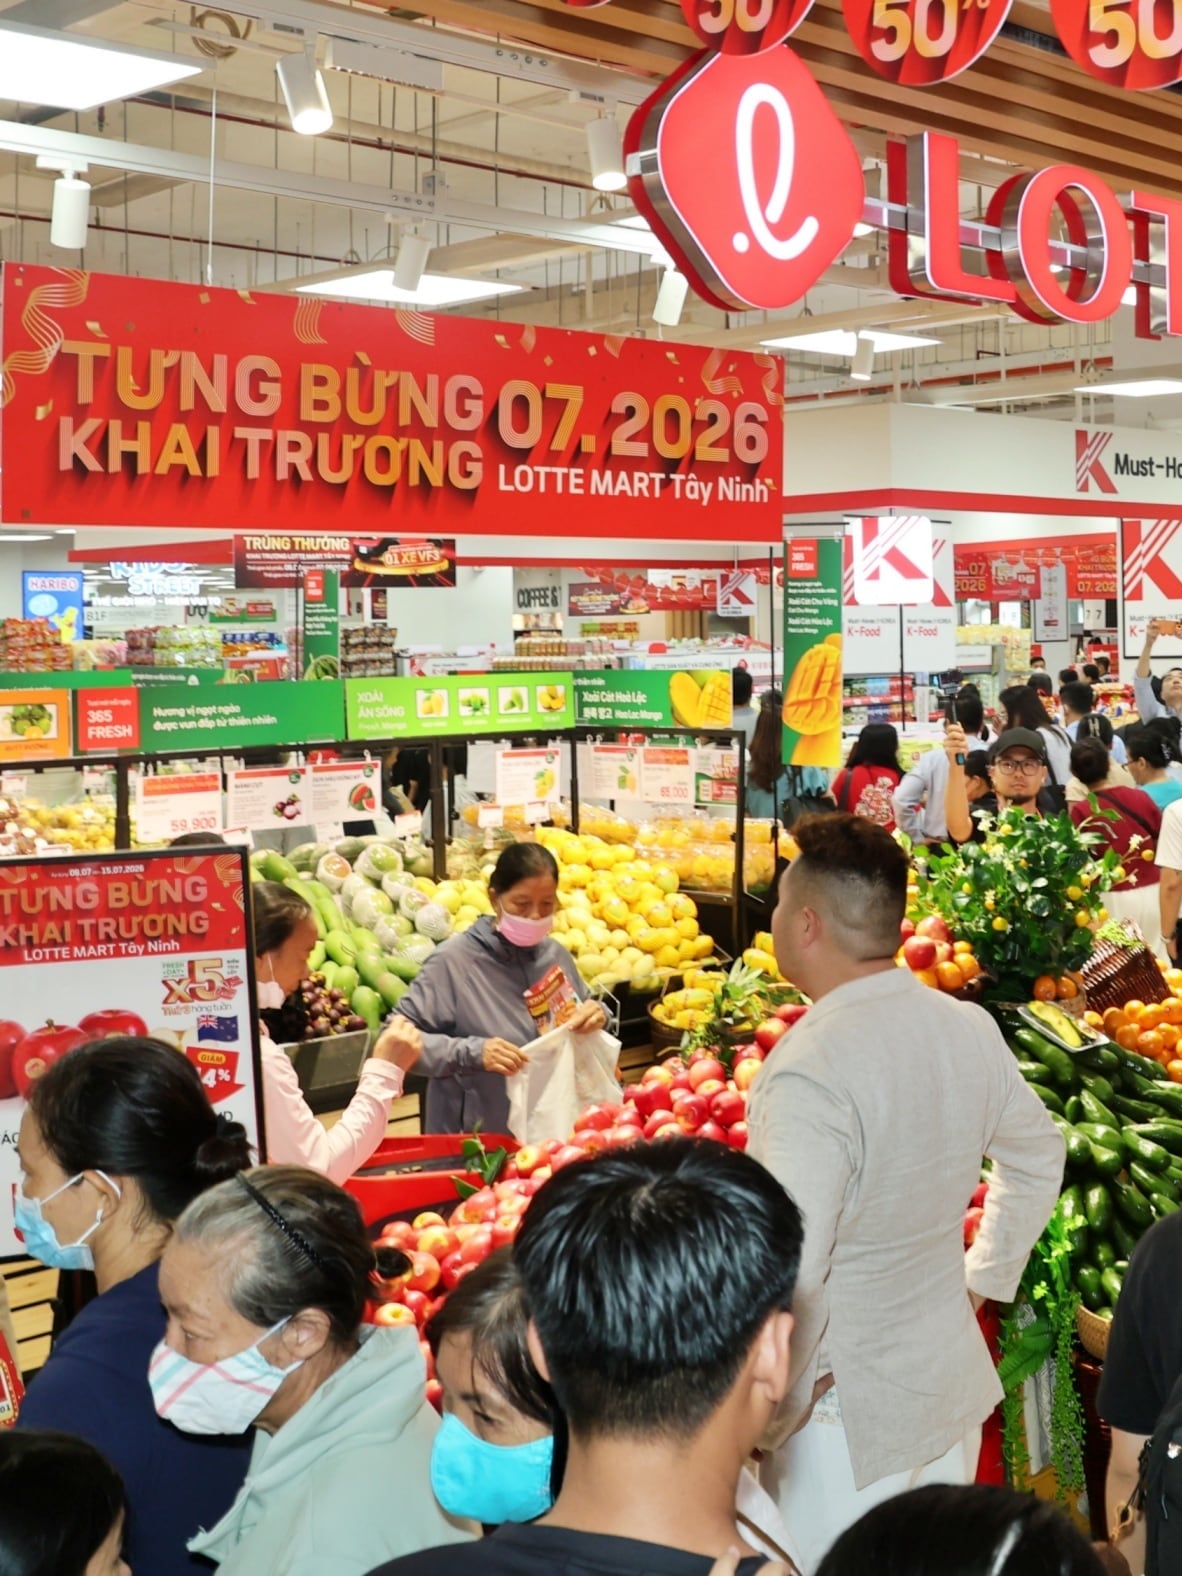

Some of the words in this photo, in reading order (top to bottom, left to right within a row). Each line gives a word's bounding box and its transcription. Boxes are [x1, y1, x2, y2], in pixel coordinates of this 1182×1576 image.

[60, 340, 282, 417] TƯNG
[300, 351, 485, 431] BỪNG
[58, 416, 220, 478] KHAI
[233, 425, 484, 490] TRƯƠNG
[498, 464, 584, 494] LOTTE
[590, 470, 666, 498] MART
[670, 472, 713, 506] Tây
[718, 477, 769, 503] Ninh
[28, 577, 78, 592] HARIBO
[128, 572, 201, 594] STREET
[517, 586, 550, 608] COFFEE
[88, 710, 112, 724] 365
[88, 725, 132, 740] FRESH
[170, 817, 218, 832] 59,900
[107, 873, 209, 910] BỪNG
[0, 919, 72, 947] KHAI
[77, 910, 210, 942] TRƯƠNG
[24, 946, 70, 962] LOTTE
[74, 944, 116, 958] MART
[120, 942, 144, 958] Tây
[148, 940, 180, 954] Ninh
